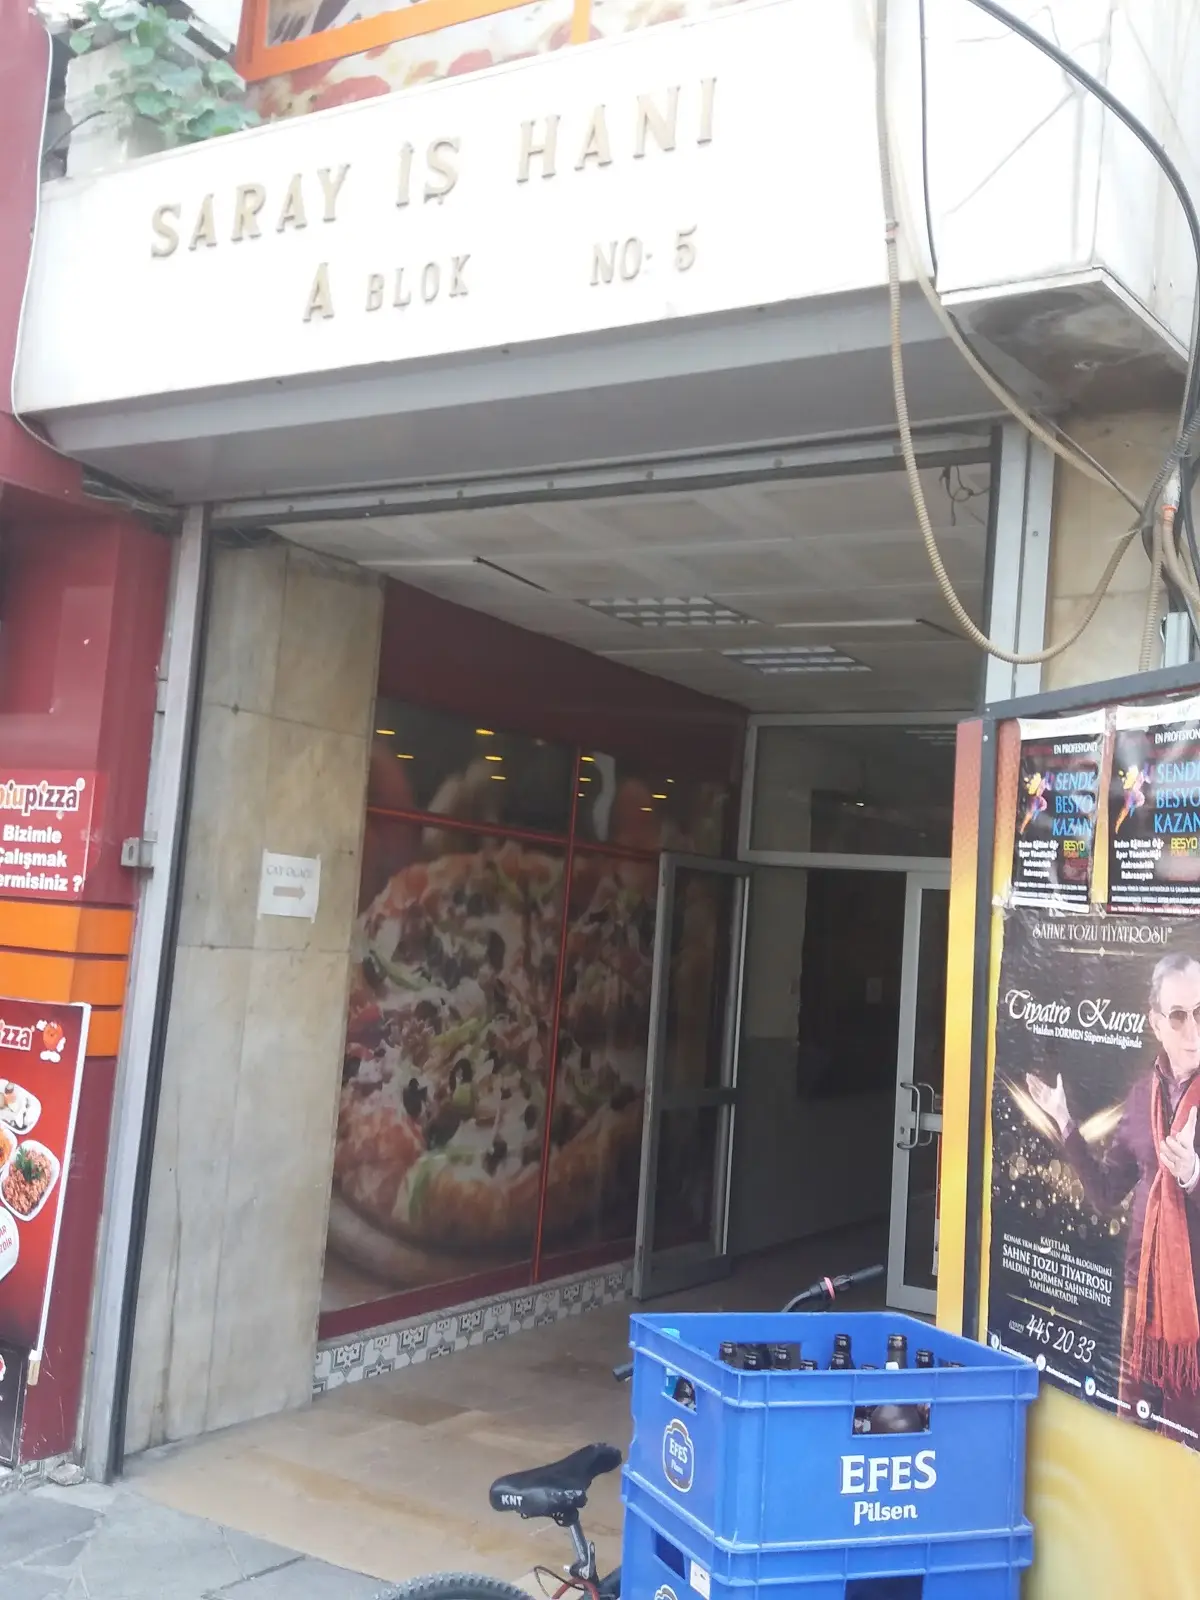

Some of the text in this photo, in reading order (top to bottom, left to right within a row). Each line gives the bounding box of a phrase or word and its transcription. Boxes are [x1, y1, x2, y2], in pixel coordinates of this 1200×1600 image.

[150, 163, 350, 259] SARAY
[516, 76, 719, 184] HANI
[302, 262, 334, 324] A
[365, 253, 472, 312] BLOK
[674, 223, 698, 274] 5
[1055, 794, 1093, 813] BESYO
[1155, 786, 1200, 809] BESYO
[3, 824, 62, 844] Bizimle
[1171, 837, 1198, 850] BESYO
[73, 875, 83, 892] ?
[1033, 923, 1066, 939] SAHNE
[1068, 924, 1098, 941] TOZU
[1005, 989, 1146, 1033] Tiyatro Kursu
[1055, 1027, 1083, 1040] DORMEN
[1003, 1243, 1112, 1293] SAHNE TOZU TİYATROSU
[1003, 1258, 1112, 1306] HALDUN DORMEN SAHNESİNDE
[1026, 1314, 1054, 1344] 445
[1052, 1326, 1075, 1354] 20
[1074, 1336, 1096, 1363] 33
[669, 1437, 688, 1464] EFES
[840, 1449, 937, 1494] EFES
[501, 1494, 523, 1507] KNT
[853, 1500, 918, 1526] Pilsen
